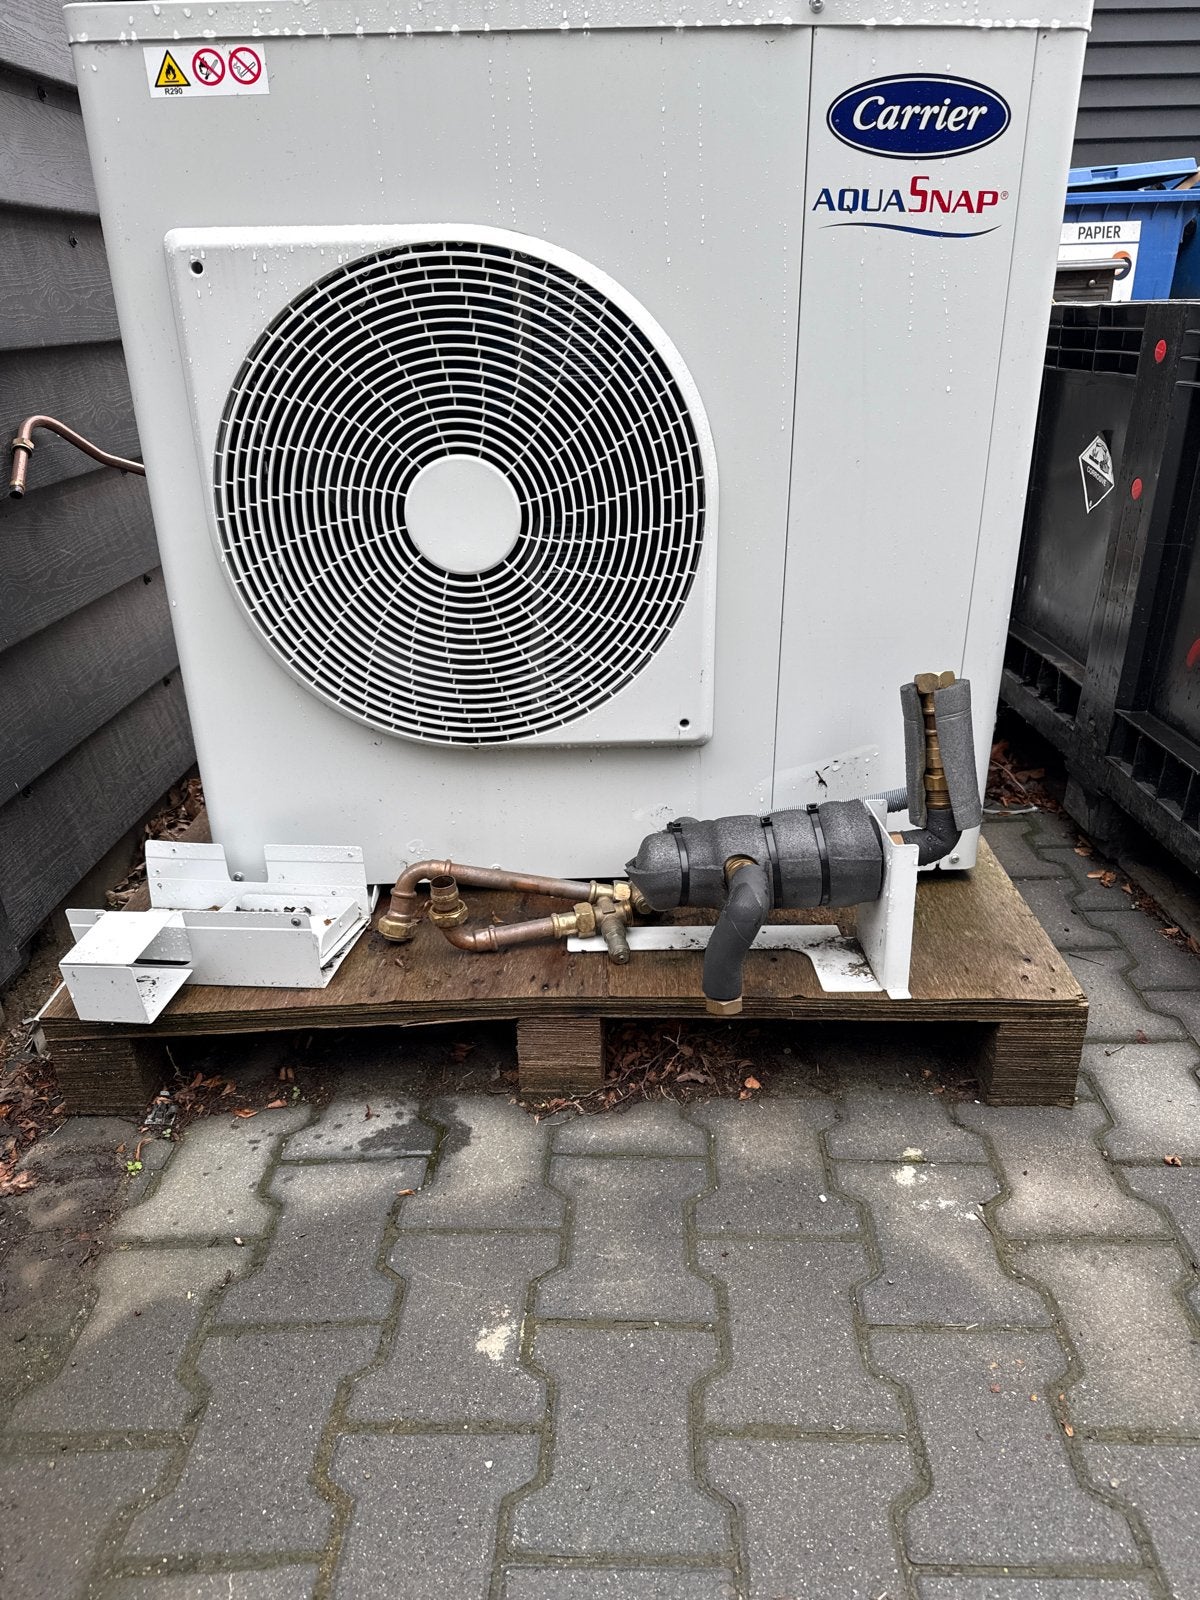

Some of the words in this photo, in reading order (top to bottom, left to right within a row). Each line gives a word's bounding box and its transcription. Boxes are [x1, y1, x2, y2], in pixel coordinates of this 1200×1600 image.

[164, 87, 183, 95] R290
[852, 95, 988, 132] Carrier
[1077, 225, 1122, 240] PAPIER
